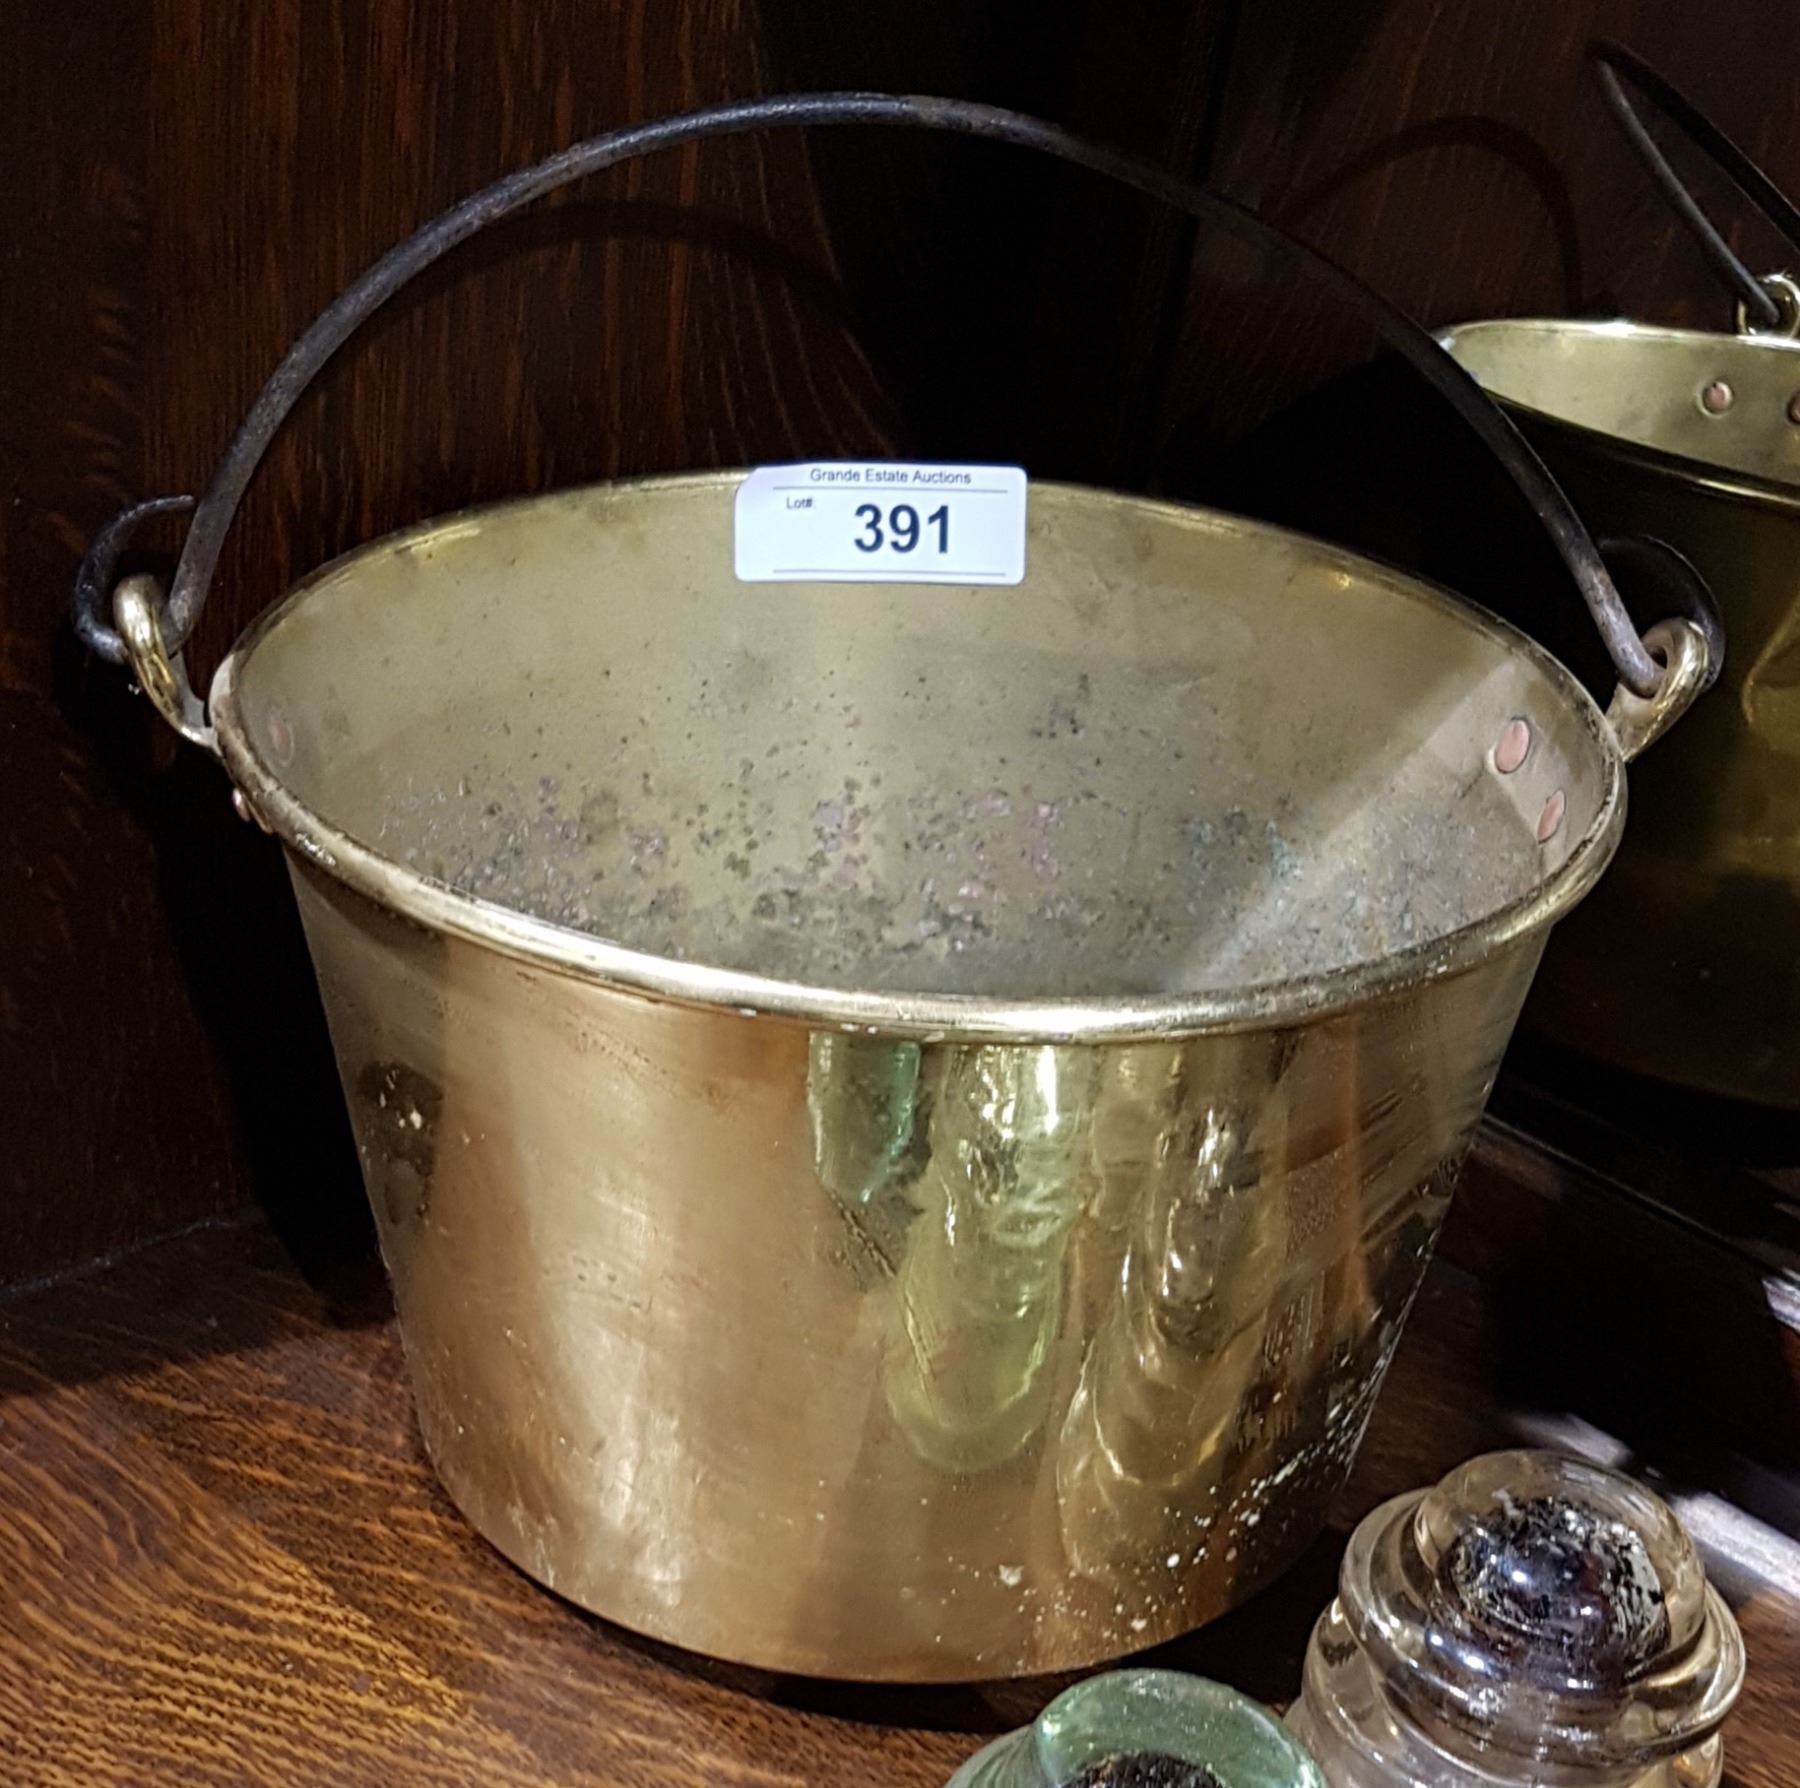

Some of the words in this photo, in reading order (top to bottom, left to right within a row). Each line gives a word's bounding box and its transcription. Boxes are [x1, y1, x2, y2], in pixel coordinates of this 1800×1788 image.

[810, 468, 861, 482] Grande
[865, 469, 908, 483] Estate
[913, 470, 972, 485] Auctions
[853, 503, 949, 554] 391
